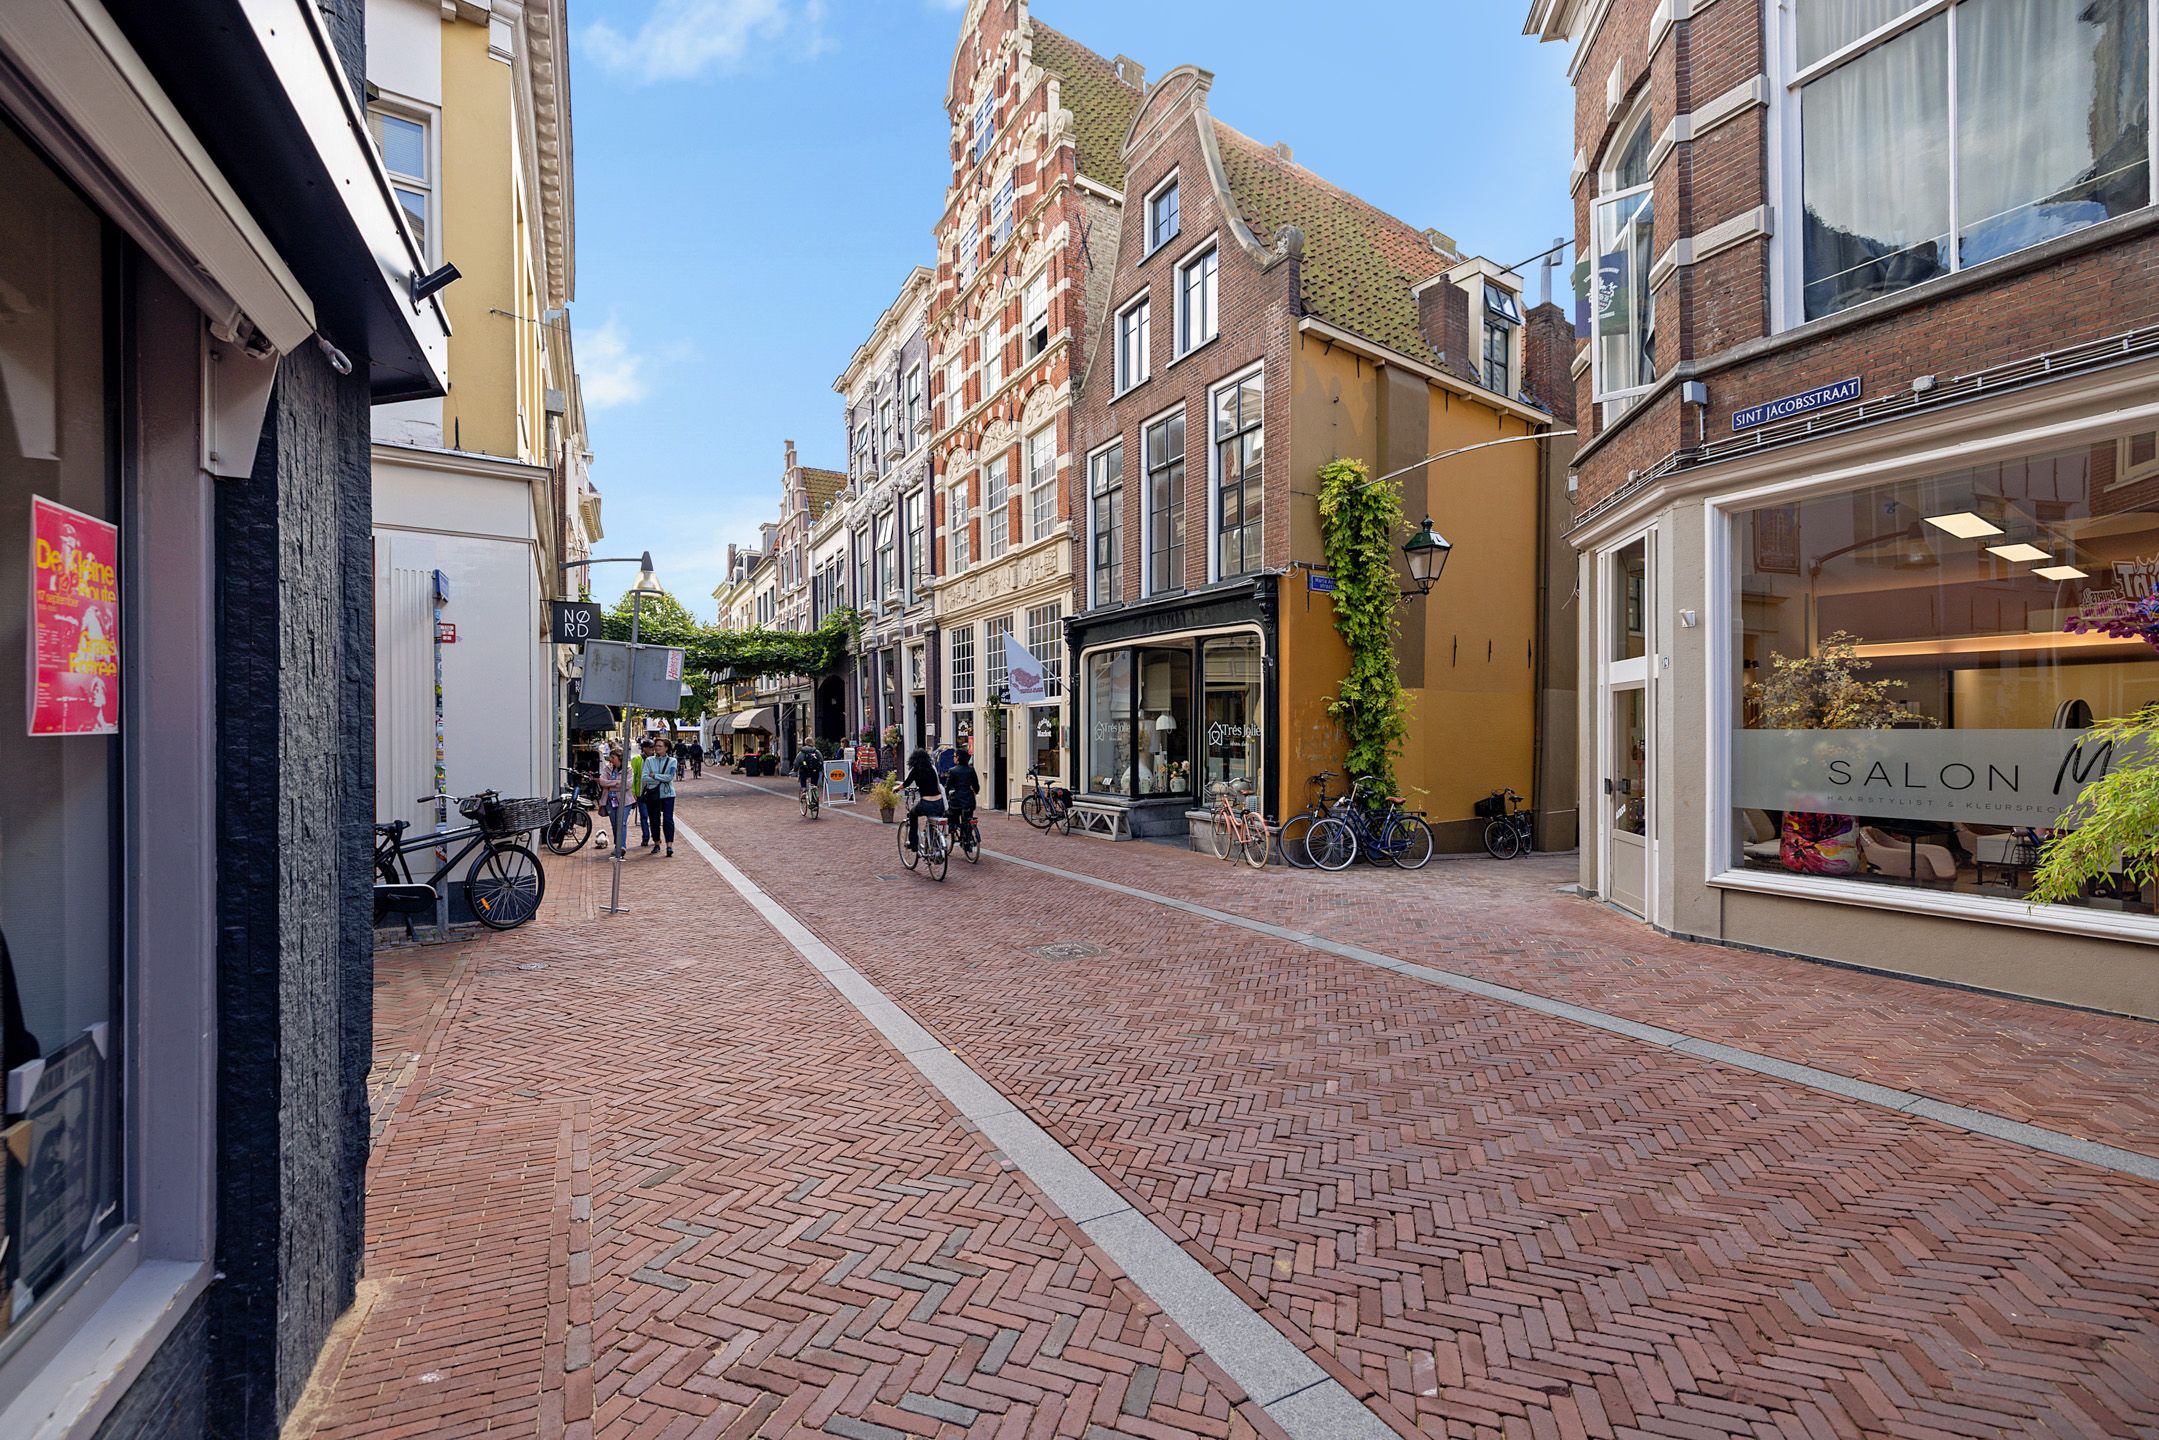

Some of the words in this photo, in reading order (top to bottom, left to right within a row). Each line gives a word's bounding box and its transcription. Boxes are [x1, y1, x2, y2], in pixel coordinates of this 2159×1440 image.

[1735, 409, 1762, 426] SINT
[1766, 381, 1857, 420] JACOBSSTRAAT
[36, 538, 61, 569] De
[78, 579, 116, 603] Route
[1242, 723, 1261, 738] Jolie
[1828, 760, 2018, 792] SALON
[1827, 795, 1933, 806] HAARSTYLIST
[1966, 802, 2063, 813] KLEURSPECI
